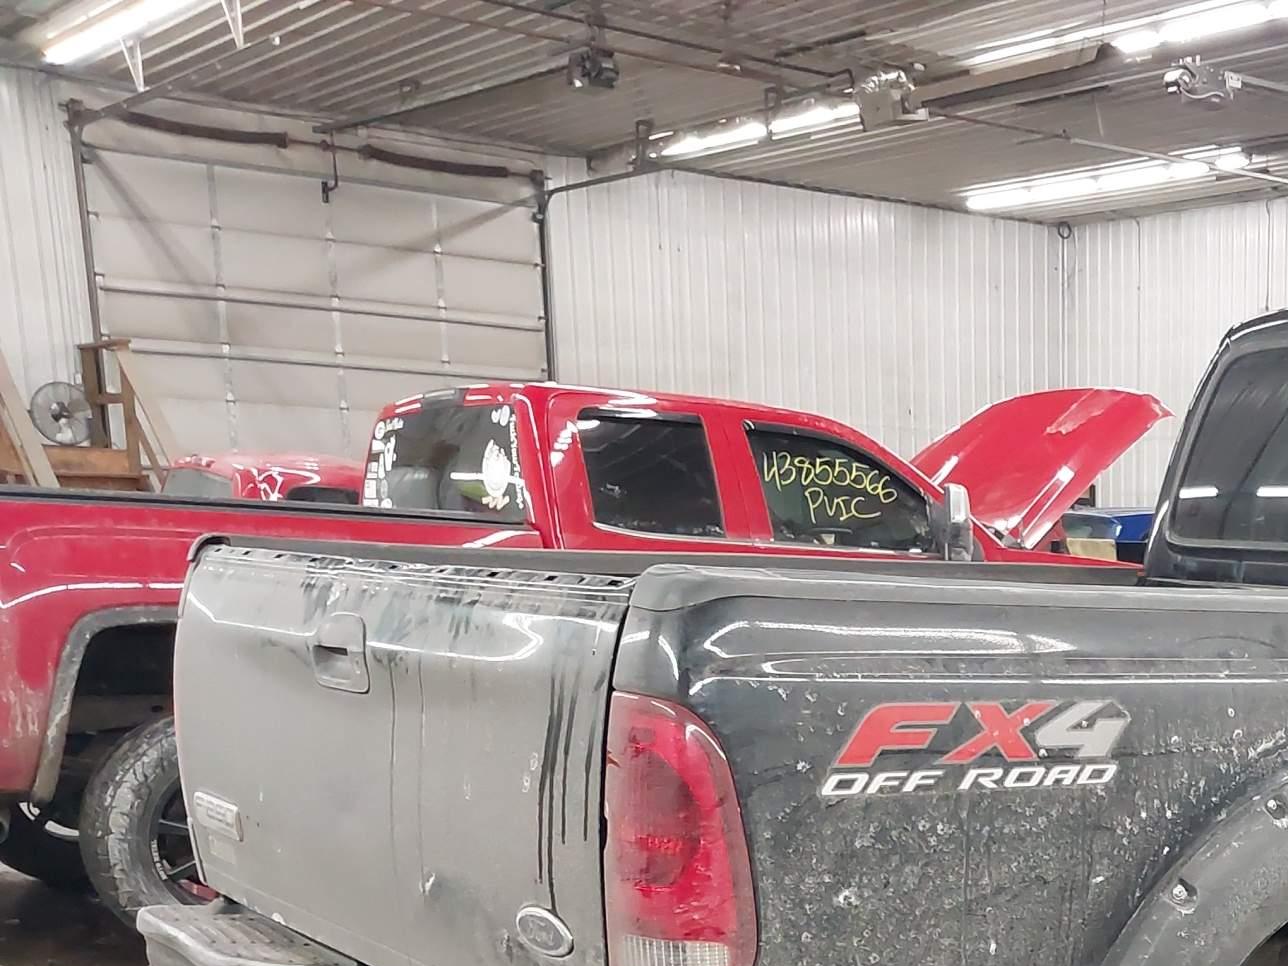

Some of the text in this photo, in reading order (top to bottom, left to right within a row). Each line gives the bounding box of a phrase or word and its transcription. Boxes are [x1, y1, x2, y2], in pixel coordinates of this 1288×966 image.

[763, 451, 898, 503] 43855566
[831, 700, 1131, 767] FX4
[821, 764, 1118, 796] OFF ROAD
